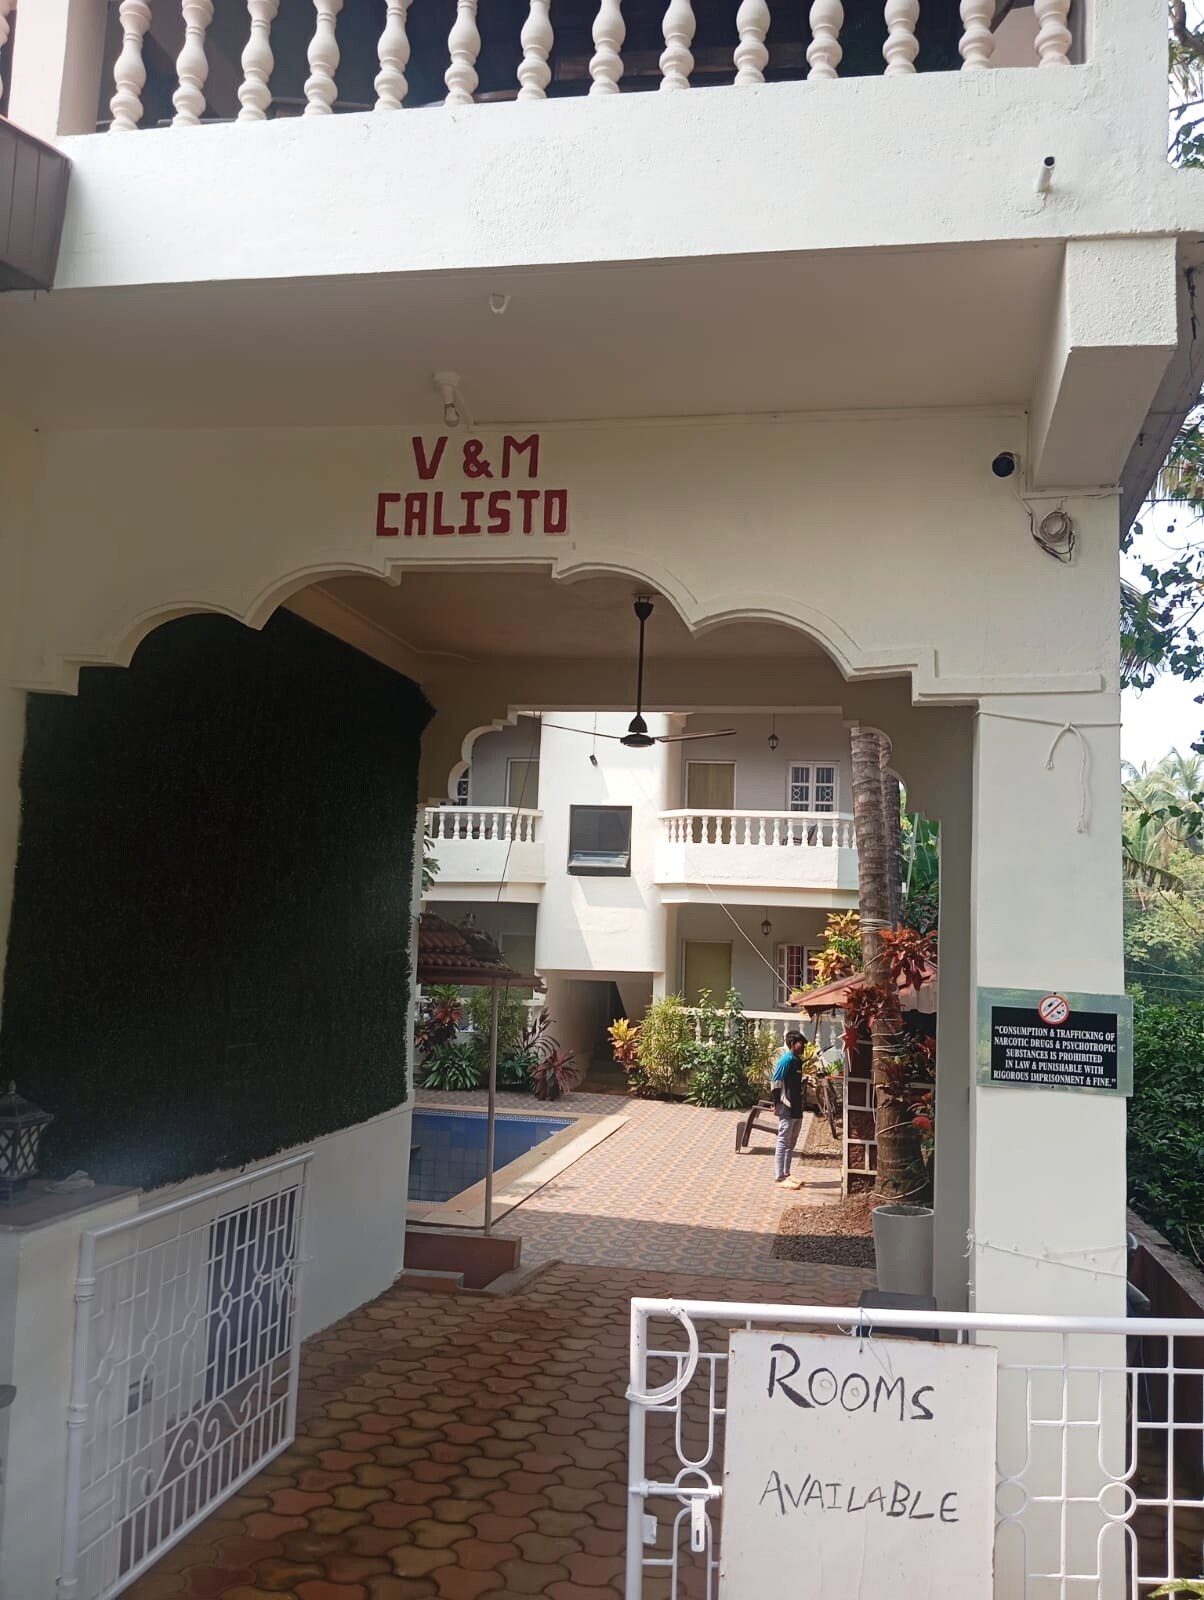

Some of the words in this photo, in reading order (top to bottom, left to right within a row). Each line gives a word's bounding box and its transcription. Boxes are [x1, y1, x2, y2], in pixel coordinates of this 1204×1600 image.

[412, 437, 448, 479] V
[463, 439, 493, 478] &
[502, 434, 539, 478] M
[376, 489, 567, 536] CALISTO
[1056, 1029, 1103, 1040] TRAFFICKING
[1105, 1033, 1115, 1041] OF
[994, 1037, 1029, 1047] NARCOTIC
[1031, 1039, 1054, 1048] DRUGS
[1062, 1042, 1116, 1052] PSYCHOTROPIC
[1006, 1049, 1048, 1059] SUBSTANCES
[1058, 1053, 1102, 1062] PROHIBITED
[1006, 1060, 1013, 1068] IN
[1015, 1061, 1030, 1069] LAW
[1038, 1063, 1082, 1073] PUNISHABLE
[1084, 1066, 1103, 1074] WITH
[994, 1070, 1029, 1080] RIGOROUS
[1031, 1073, 1084, 1085] IMPRISONMENT
[767, 1343, 934, 1421] ROOMS
[759, 1470, 959, 1522] AVAILABLE
